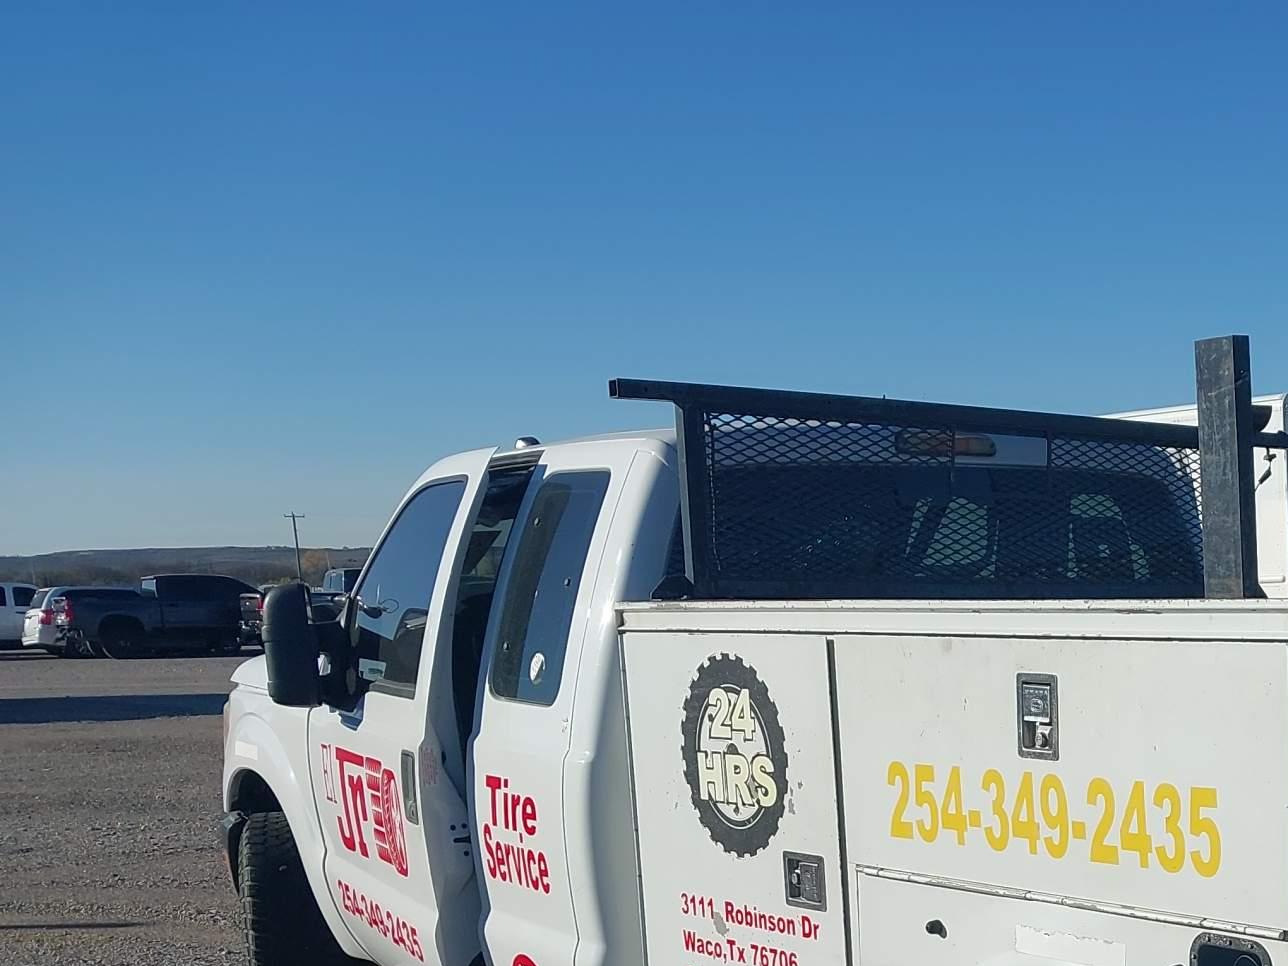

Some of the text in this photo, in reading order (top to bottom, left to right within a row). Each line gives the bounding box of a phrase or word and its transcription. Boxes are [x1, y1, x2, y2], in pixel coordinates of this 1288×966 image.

[708, 687, 756, 742] 24
[335, 746, 369, 858] Jr
[485, 774, 537, 836] Tire
[697, 751, 777, 808] HRS
[887, 760, 1222, 878] 254-349-2435
[483, 822, 550, 894] Service
[337, 879, 425, 963] 254-349-2435
[681, 892, 820, 940] 3111 Robinson Dr
[683, 929, 747, 964] Waco,Tx
